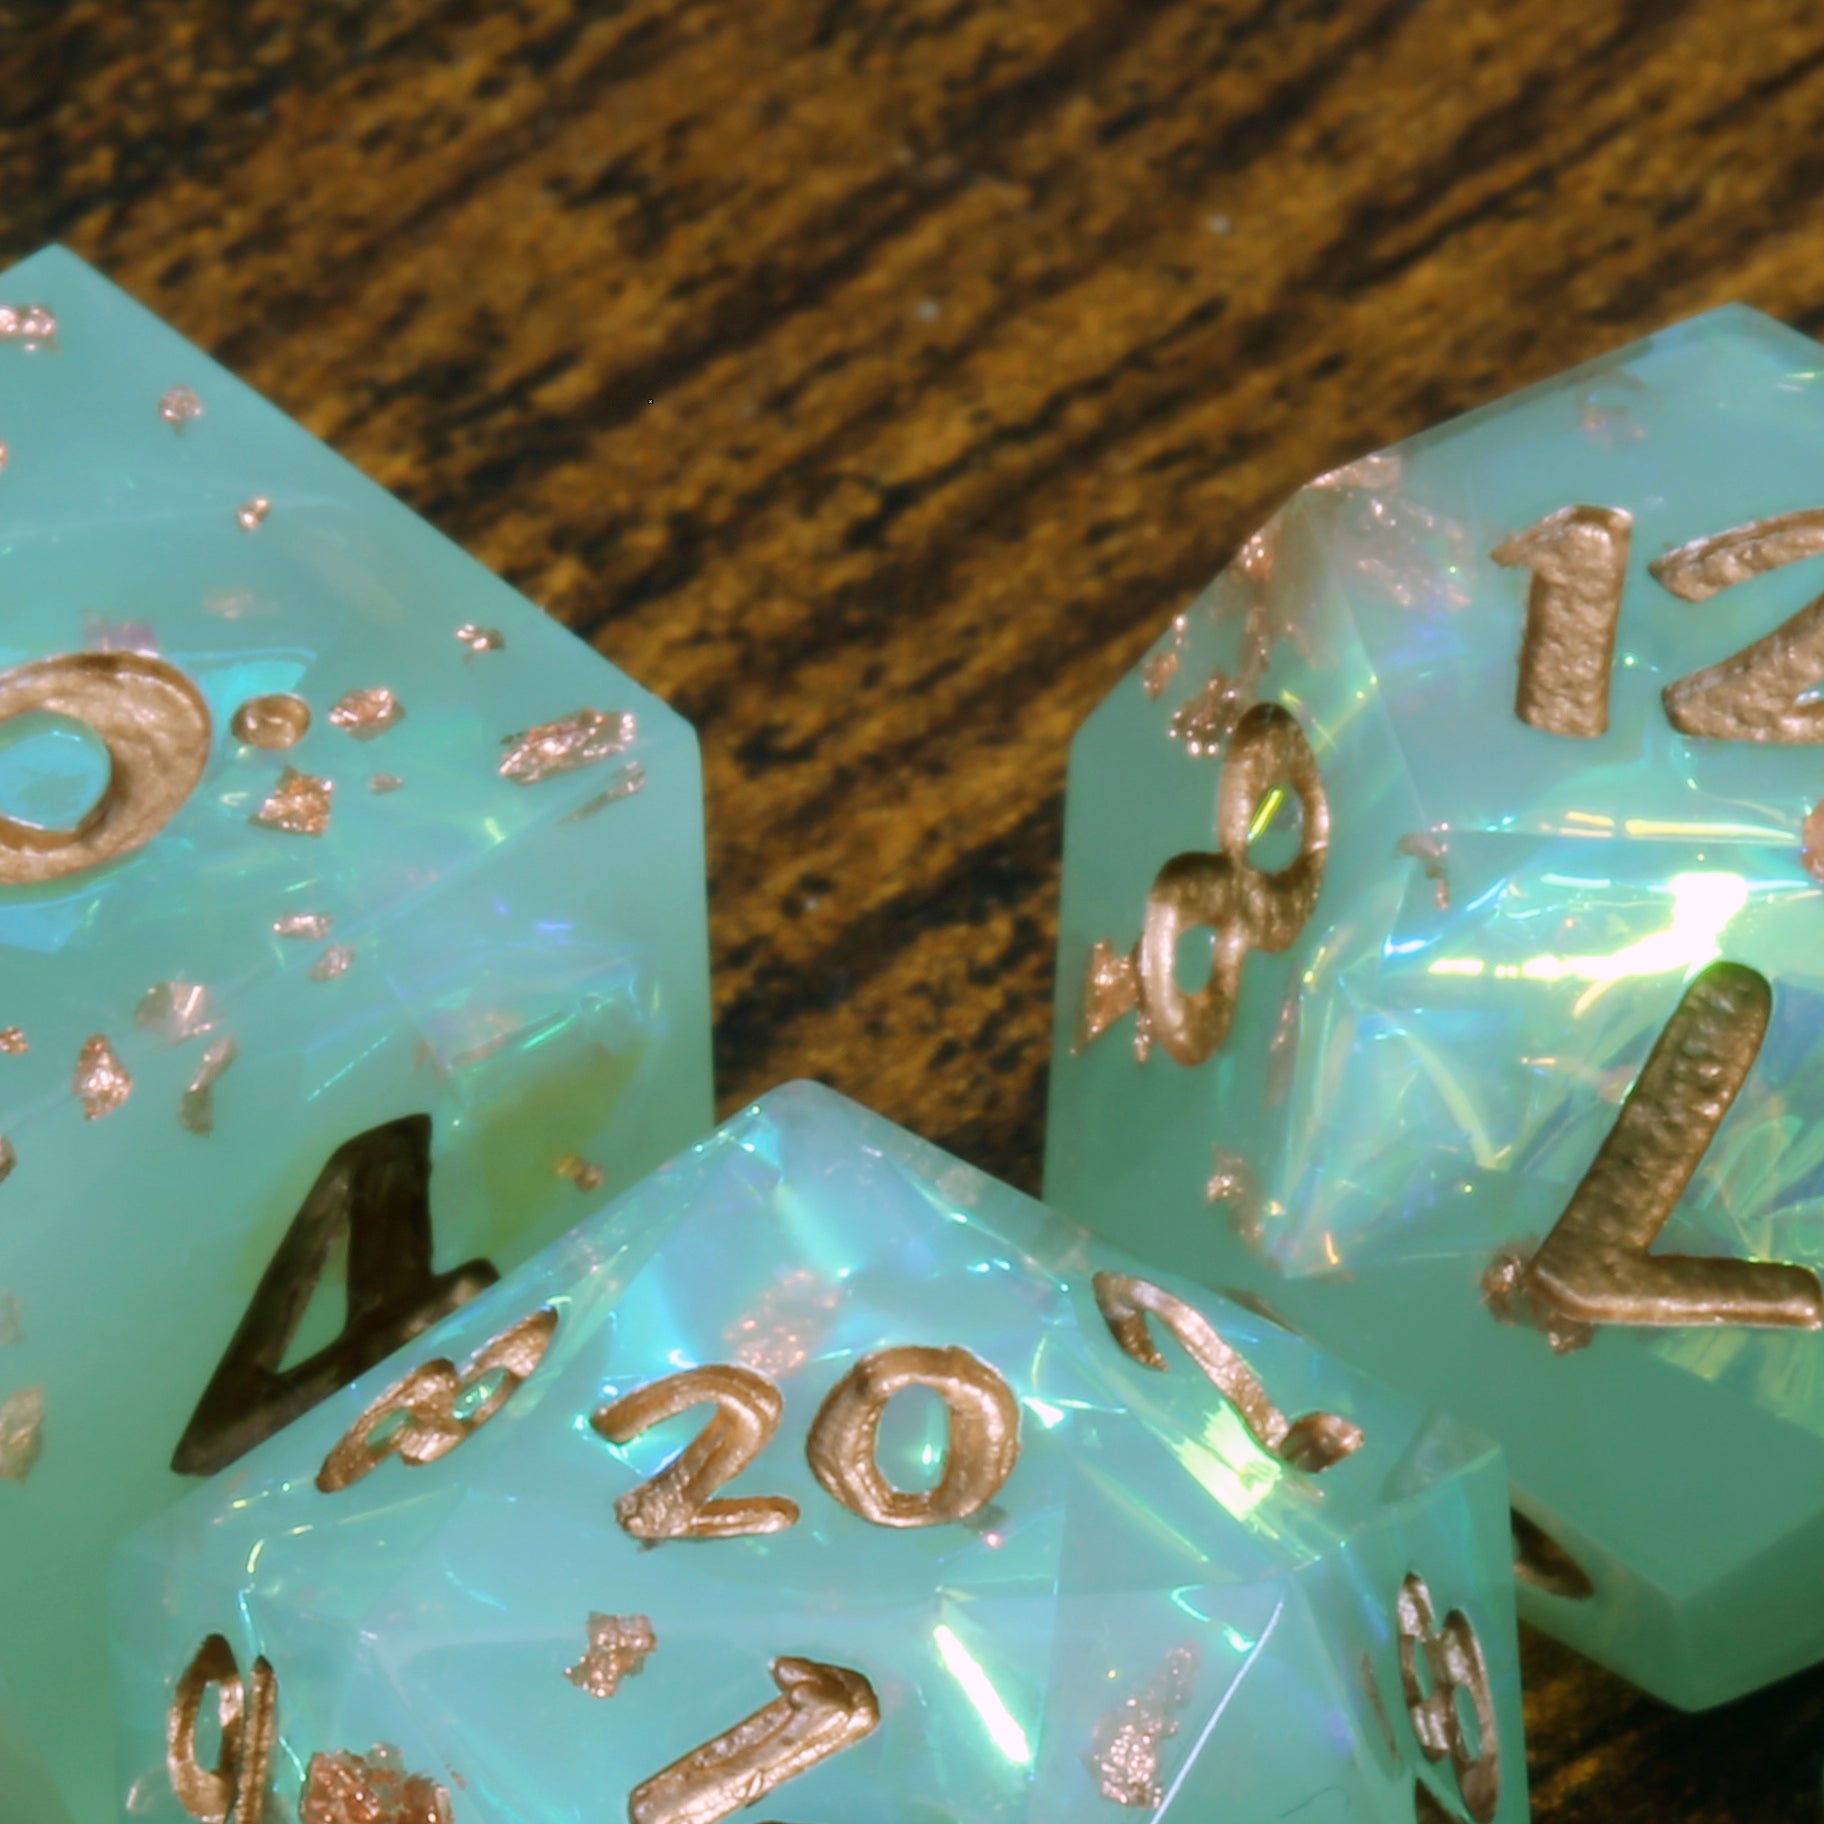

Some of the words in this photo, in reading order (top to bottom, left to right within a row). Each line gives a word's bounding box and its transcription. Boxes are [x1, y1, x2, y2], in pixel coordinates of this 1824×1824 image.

[1136, 703, 1329, 1067] 8
[170, 1112, 500, 1476] 4
[1522, 959, 1824, 1328] 7
[316, 1305, 560, 1493] 8
[590, 1343, 1022, 1547] 20
